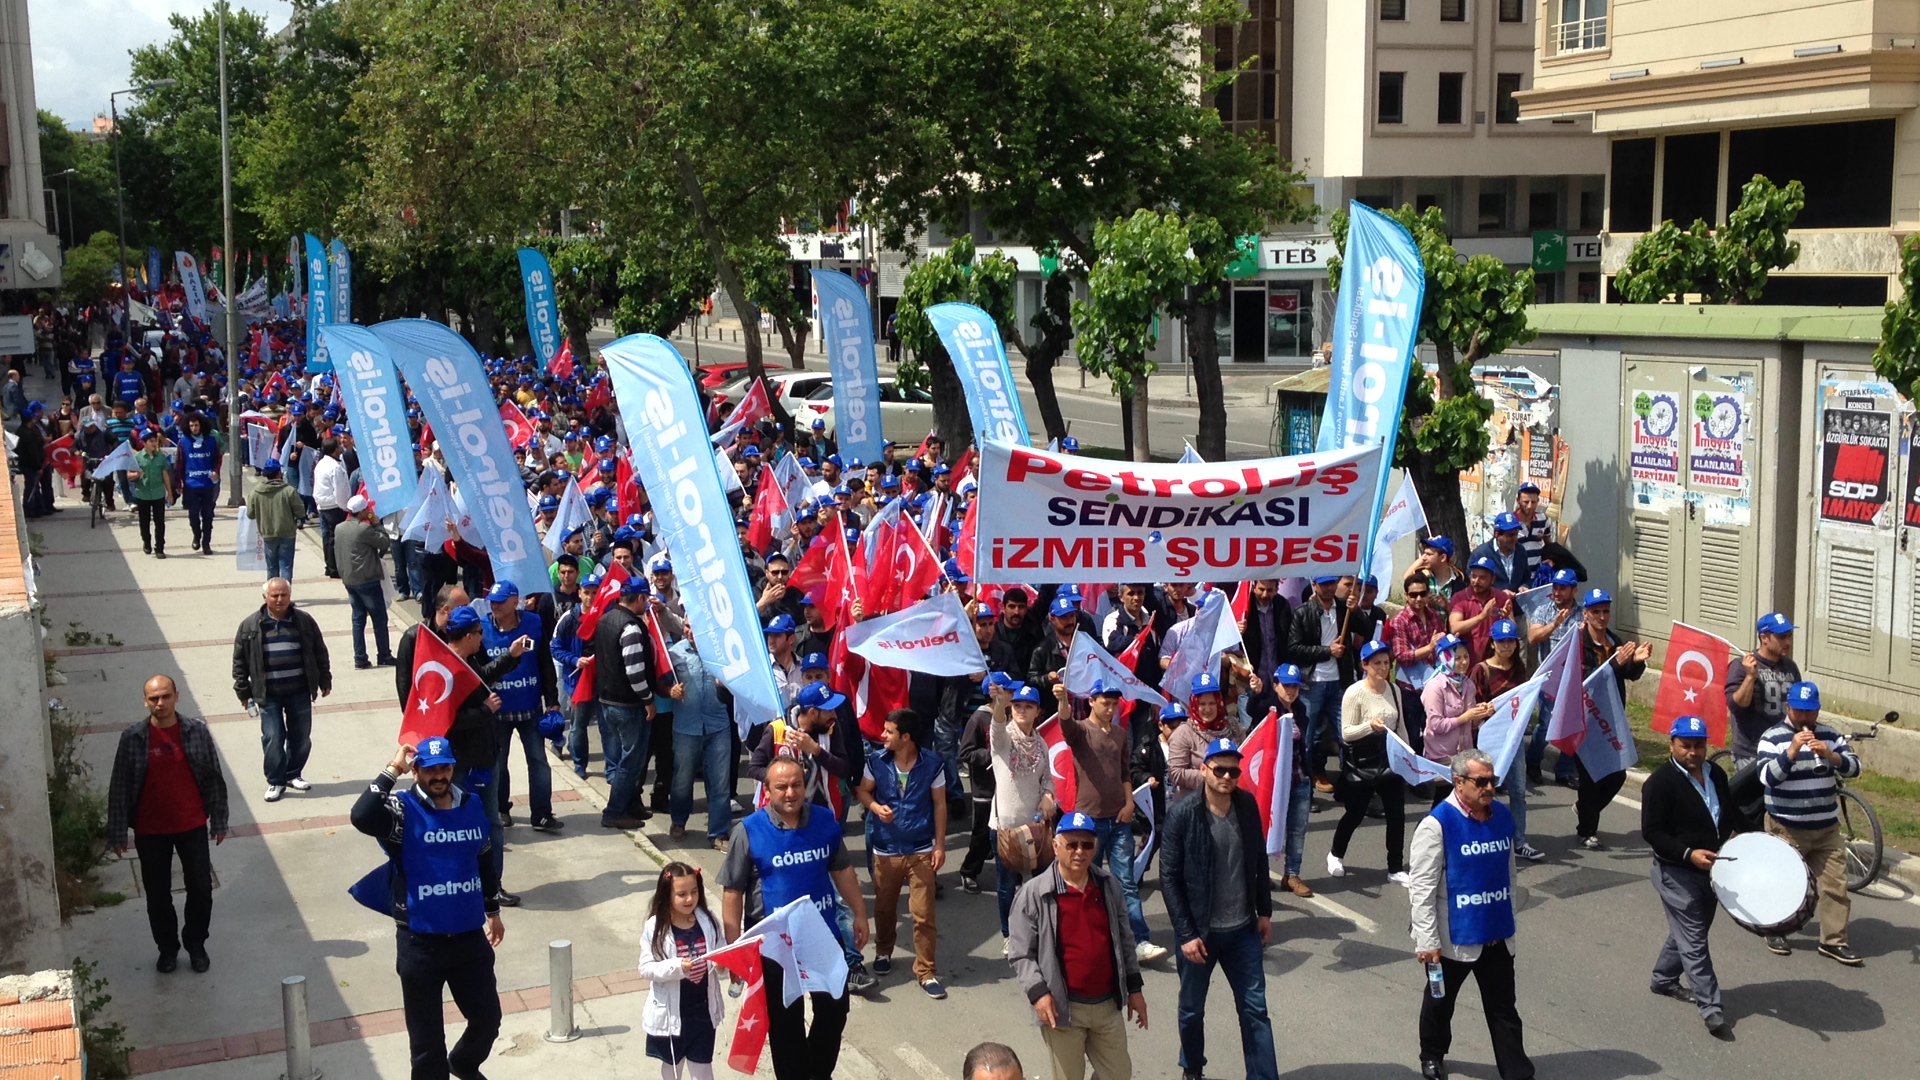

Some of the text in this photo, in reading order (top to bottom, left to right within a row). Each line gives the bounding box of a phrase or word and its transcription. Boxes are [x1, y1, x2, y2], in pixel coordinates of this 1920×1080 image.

[1270, 249, 1316, 264] TEB
[1573, 243, 1601, 257] TE
[1848, 402, 1872, 410] KONSER
[1826, 432, 1888, 448] ÖZGÜRLÜK SOKAKTA
[1006, 450, 1359, 497] Petrol-iş
[1634, 468, 1676, 483] PARTİZAN
[1693, 471, 1739, 487] PARTİZAN
[1828, 480, 1878, 500] SDP
[1822, 497, 1830, 515] 1
[424, 827, 482, 843] GÖREVLİ
[1461, 836, 1511, 856] GÖREVLİ
[772, 844, 830, 867] GÖREVLİ
[418, 875, 482, 900] petrol-iş
